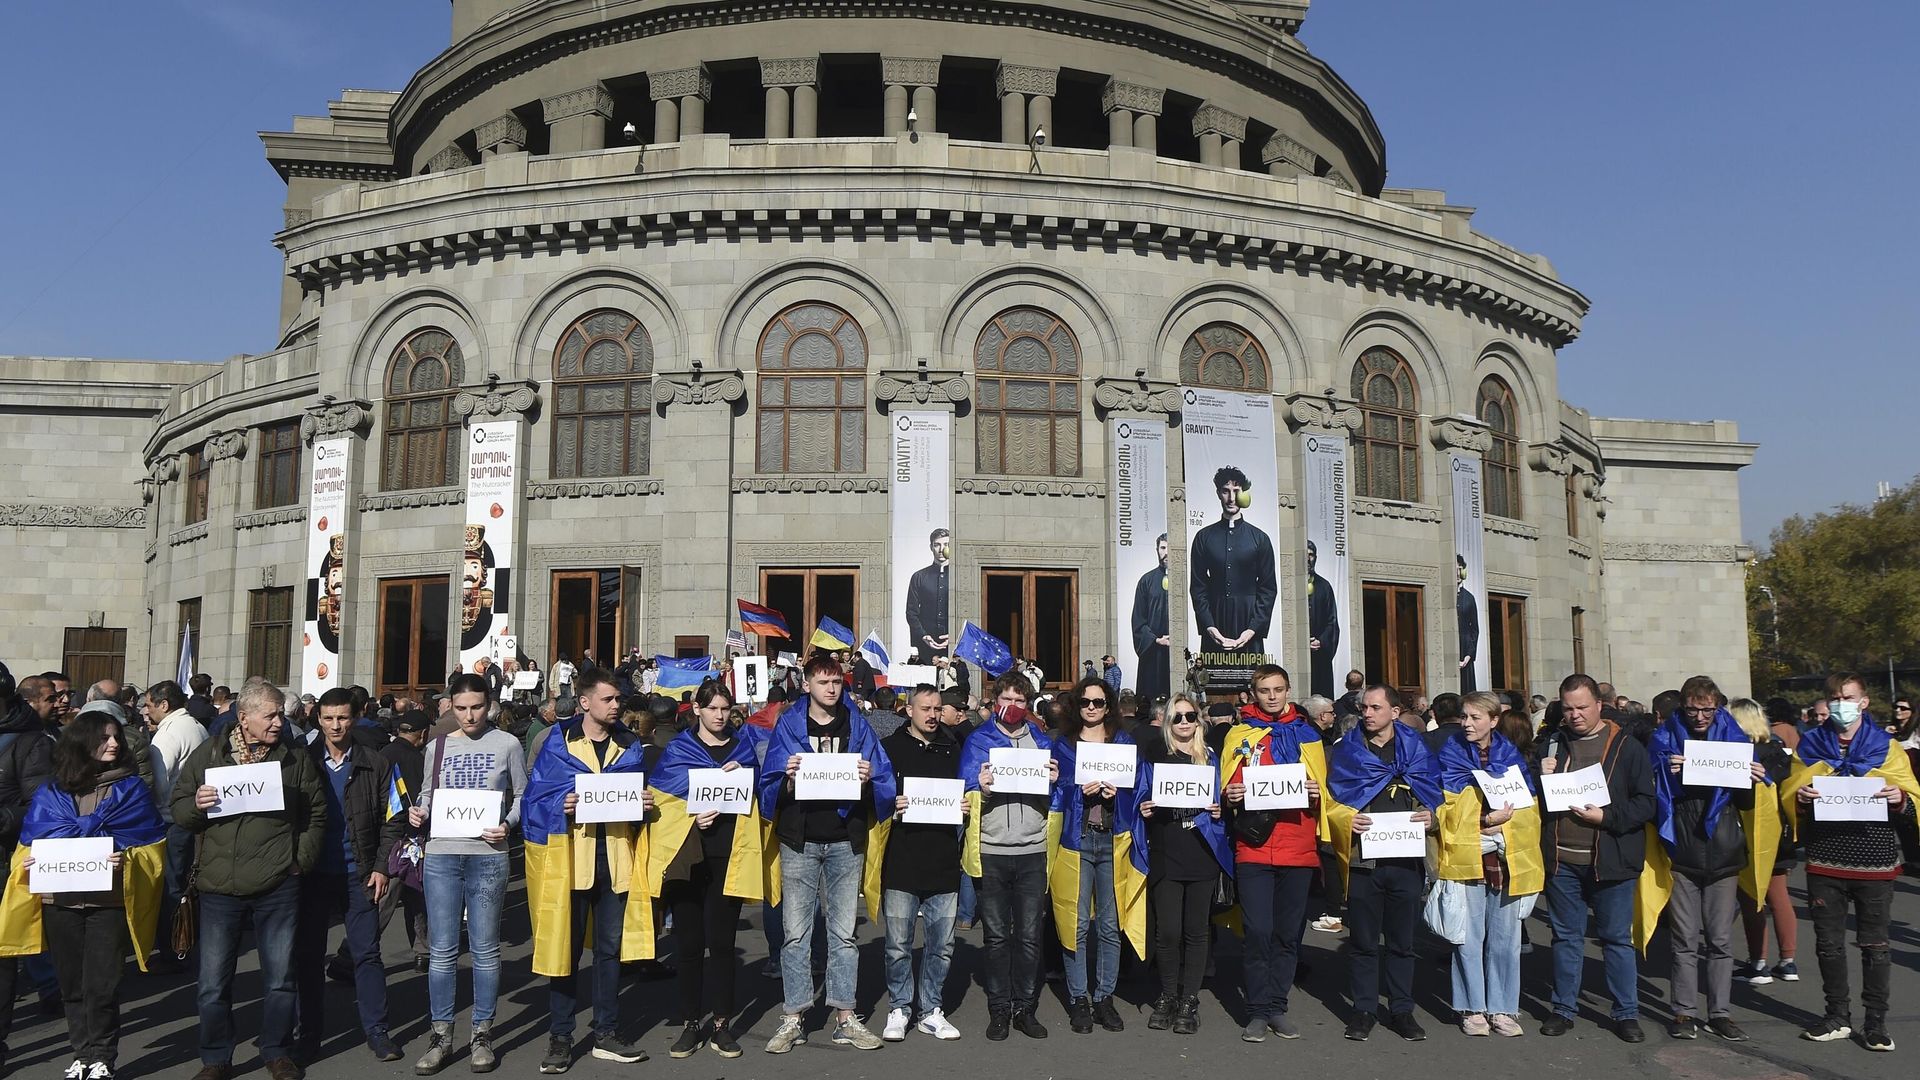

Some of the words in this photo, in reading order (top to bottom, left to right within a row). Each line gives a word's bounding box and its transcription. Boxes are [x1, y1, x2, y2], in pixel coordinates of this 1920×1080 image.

[1185, 424, 1214, 435] GRAVITY
[897, 437, 910, 482] GRAVITY
[1471, 479, 1480, 518] GRAVITY
[441, 753, 495, 771] PEACE
[1081, 762, 1134, 773] KHERSON
[1691, 759, 1748, 770] MARIUPOL
[802, 771, 858, 781] MARIUPOL
[992, 766, 1046, 777] AZOVSTAL
[446, 771, 488, 788] LOVE
[222, 782, 265, 798] KYIV
[695, 787, 749, 801] IRPEN
[1159, 781, 1211, 797] IRPEN
[1251, 780, 1303, 797] IZUM
[1483, 781, 1524, 795] BUCHA
[1551, 782, 1604, 796] MARIUPOL
[584, 790, 639, 804] BUCHA
[911, 797, 955, 807] KHARKIV
[1817, 795, 1884, 805] AZOVSTAL
[446, 807, 485, 821] KYIV
[1364, 830, 1422, 841] AZOVSTAL
[38, 861, 109, 873] KHERSON
